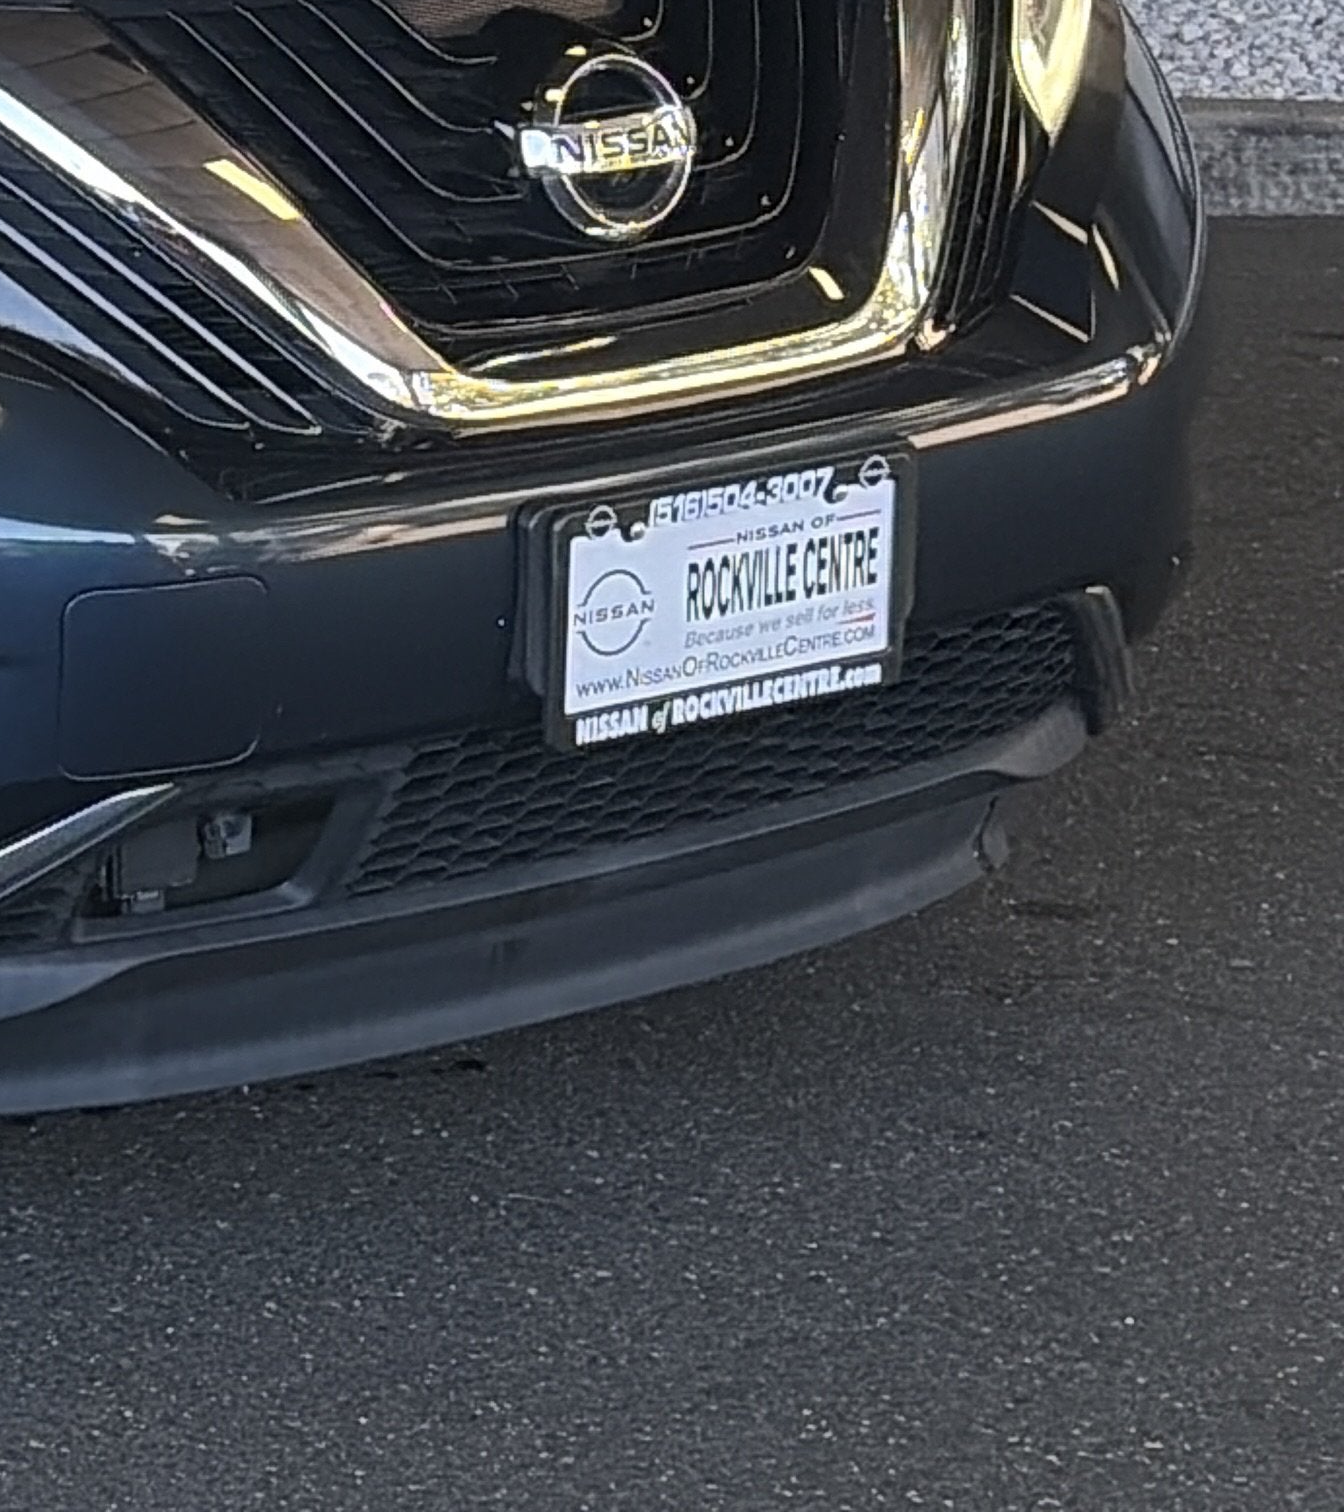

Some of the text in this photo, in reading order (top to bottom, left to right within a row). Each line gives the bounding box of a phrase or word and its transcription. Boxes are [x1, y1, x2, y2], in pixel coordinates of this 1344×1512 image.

[550, 112, 691, 165] NISSAN
[648, 466, 835, 529] (516)504-3007
[736, 513, 836, 545] NISSAN OF
[686, 525, 880, 623] ROCKVILLE CENTRE
[574, 597, 655, 627] NISSAN
[684, 622, 755, 650] Because
[758, 616, 782, 634] we
[816, 601, 840, 621] for
[575, 703, 649, 747] NISSAN
